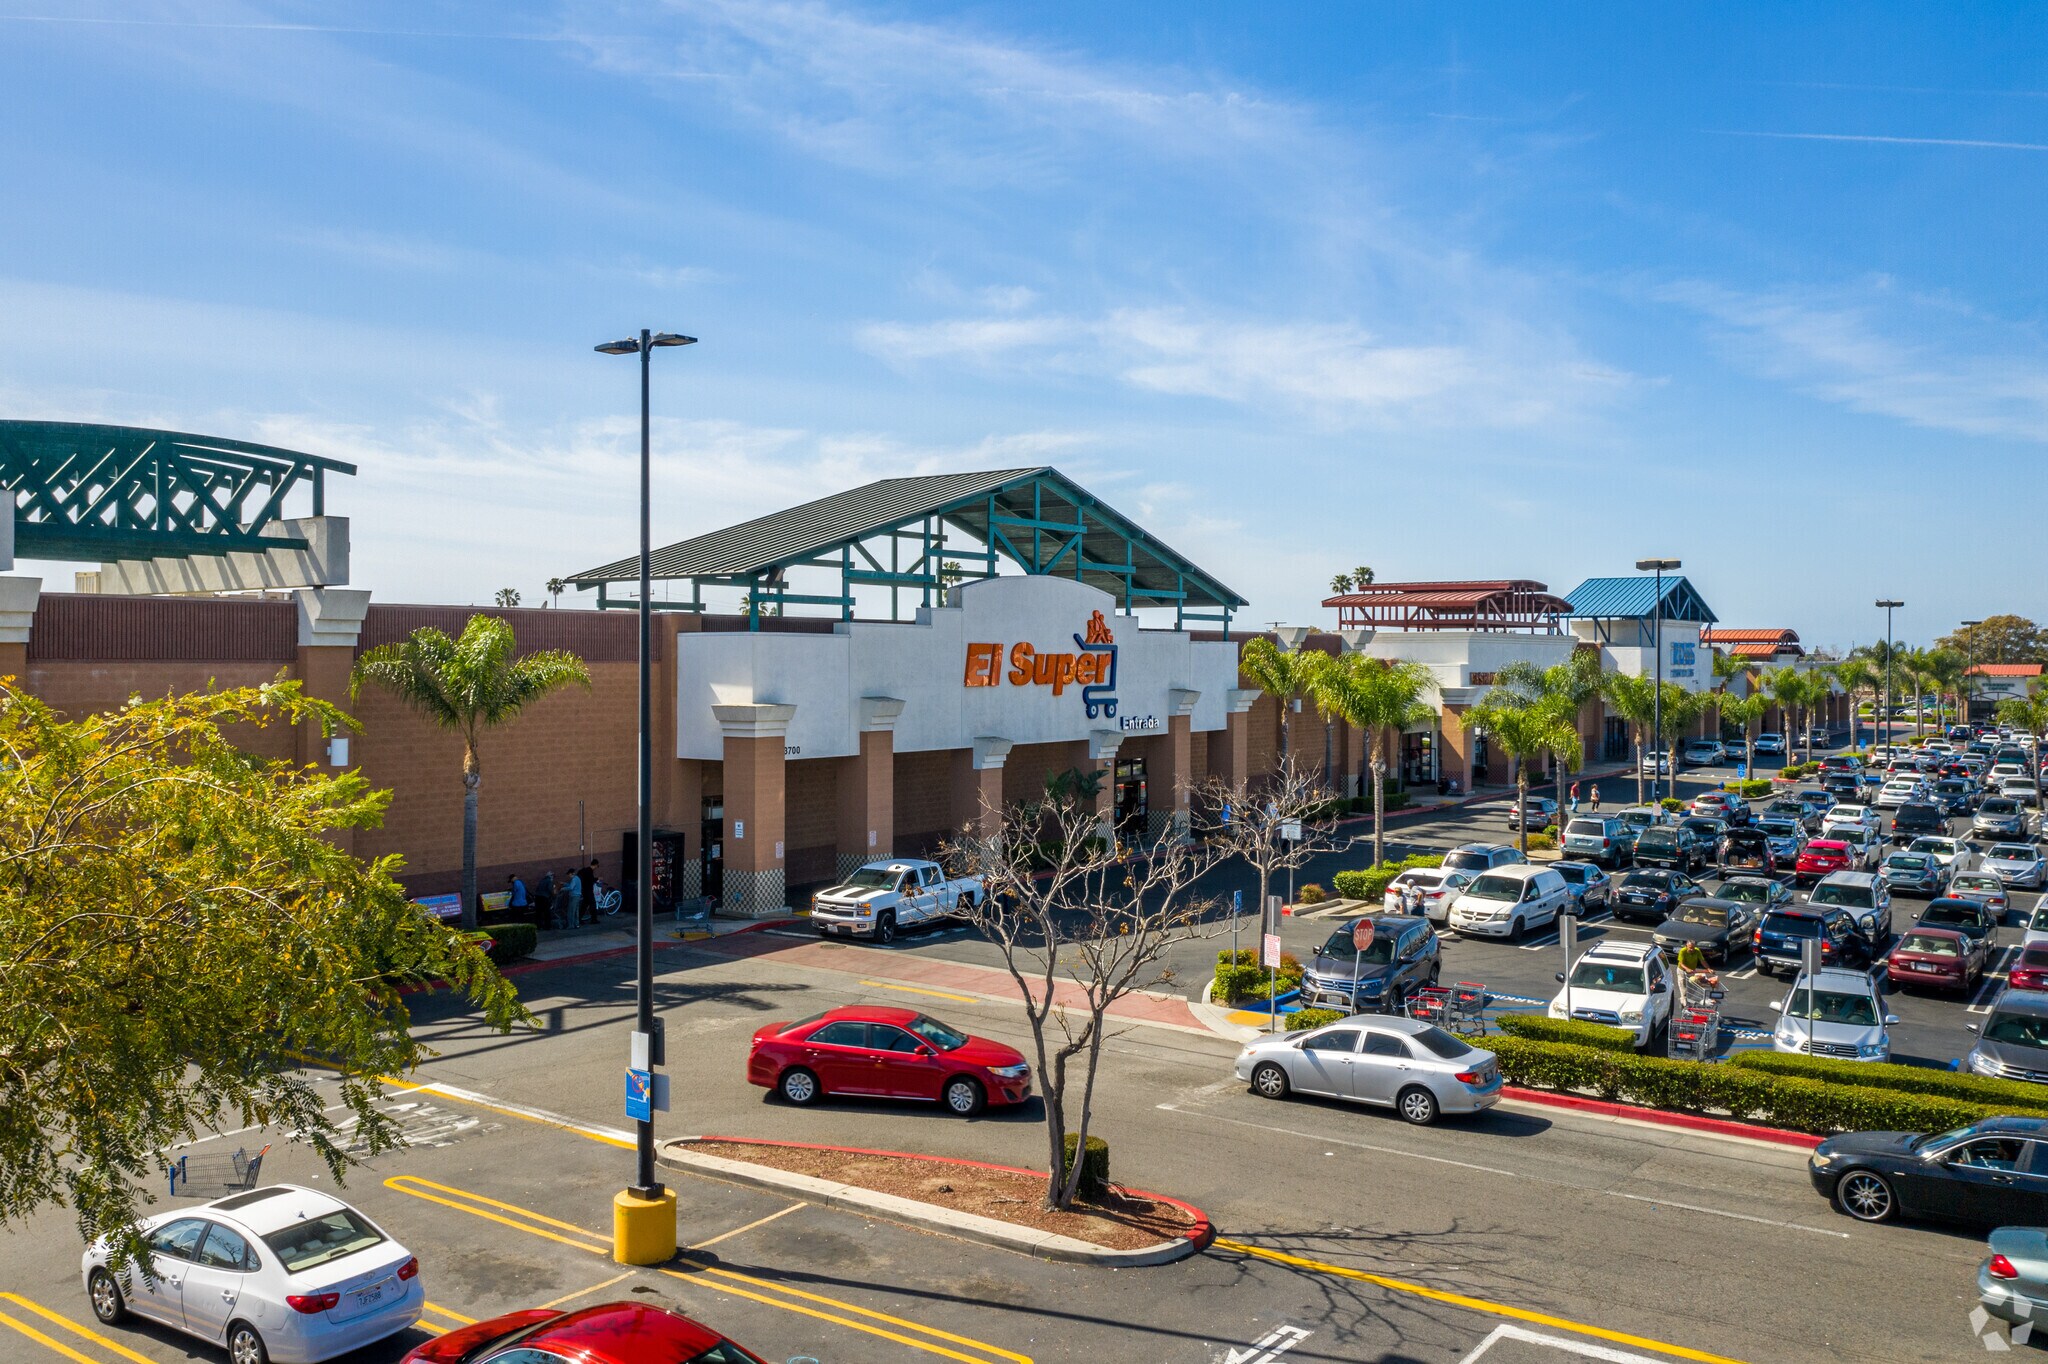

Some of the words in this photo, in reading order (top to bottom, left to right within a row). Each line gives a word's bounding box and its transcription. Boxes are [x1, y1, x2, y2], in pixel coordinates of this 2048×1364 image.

[964, 642, 1004, 687] El
[1008, 641, 1112, 696] Super
[1121, 715, 1160, 730] Entrada
[1355, 928, 1373, 941] STOP
